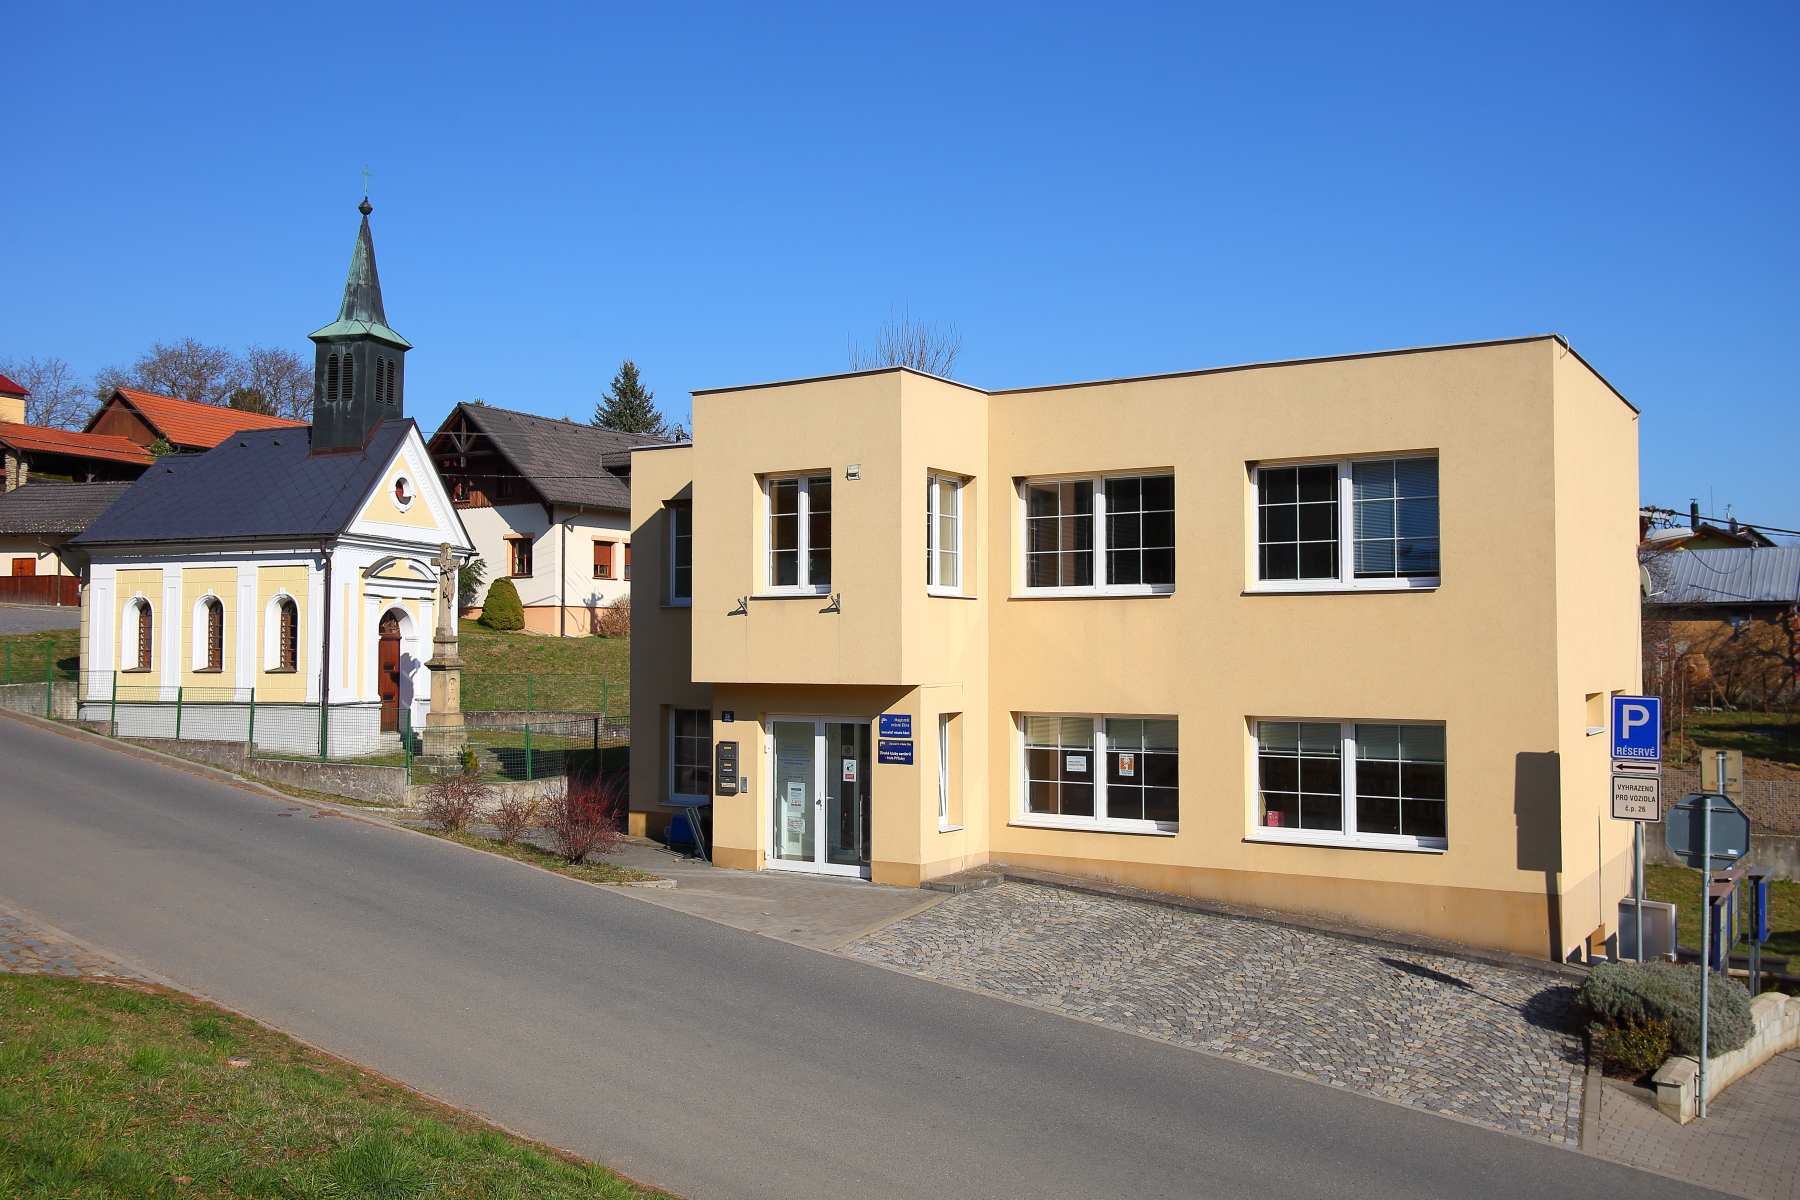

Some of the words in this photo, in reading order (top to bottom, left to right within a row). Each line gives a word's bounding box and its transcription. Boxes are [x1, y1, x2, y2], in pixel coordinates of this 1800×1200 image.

[1622, 704, 1650, 739] P
[1616, 745, 1655, 757] RÉSERVÉ
[1617, 784, 1654, 792] VYHRAZENO
[1629, 795, 1656, 803] VOZIDLA
